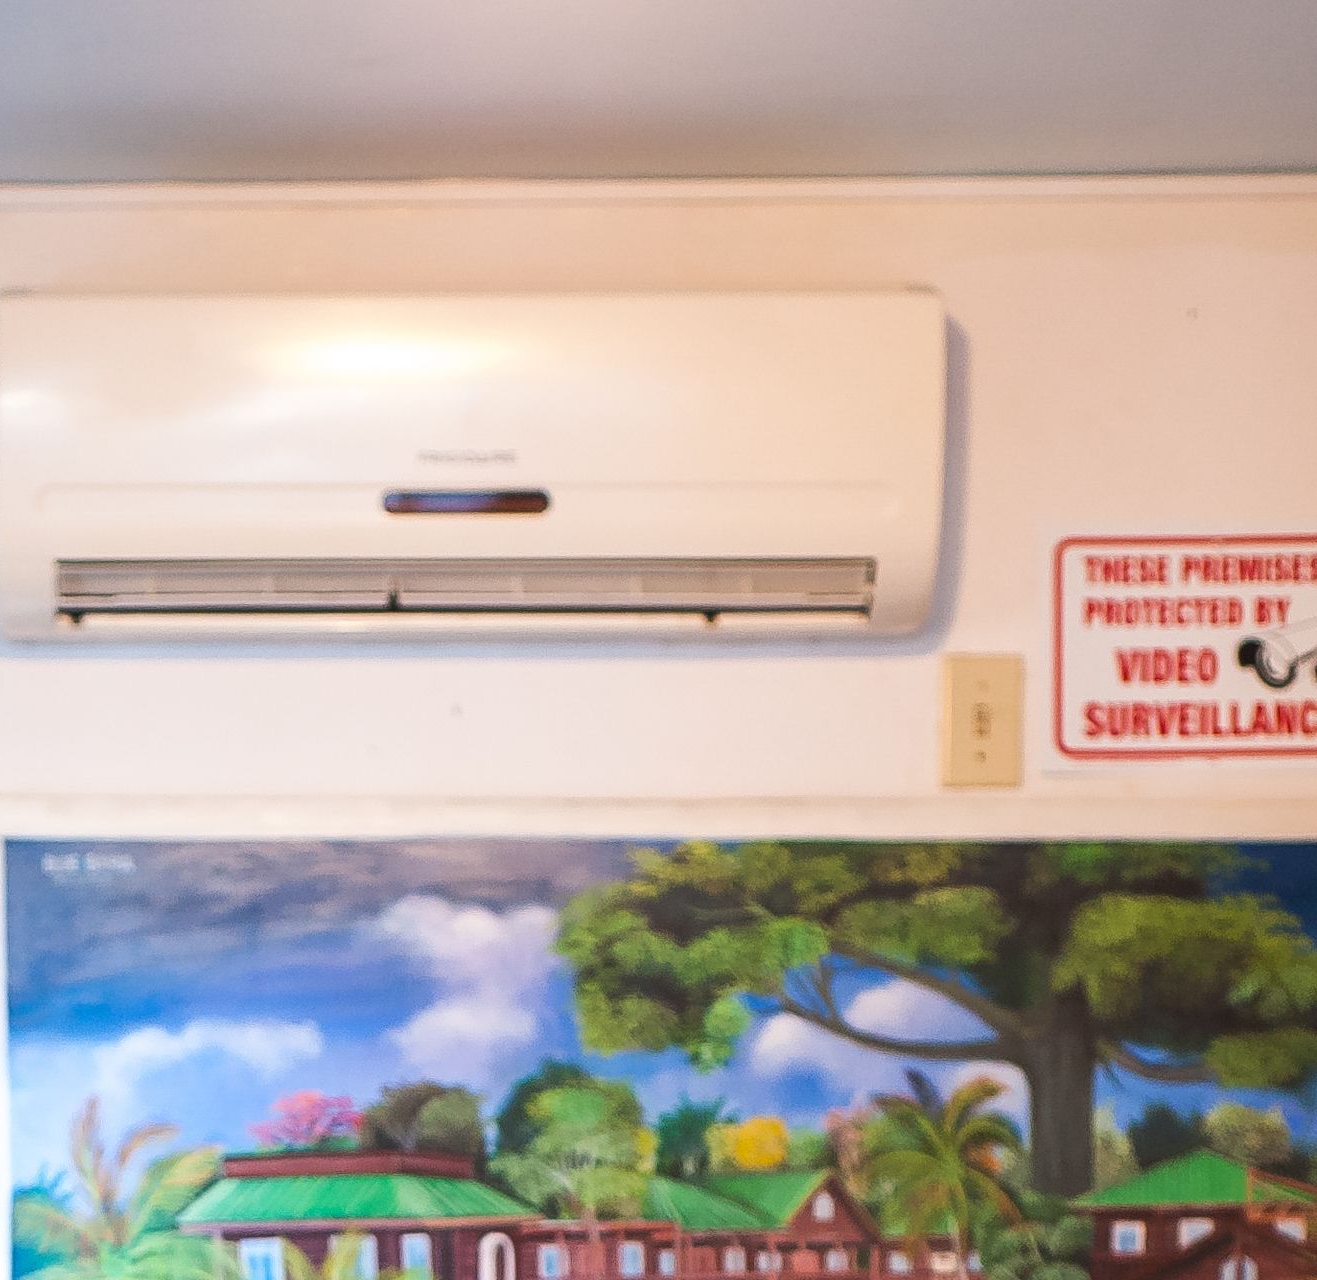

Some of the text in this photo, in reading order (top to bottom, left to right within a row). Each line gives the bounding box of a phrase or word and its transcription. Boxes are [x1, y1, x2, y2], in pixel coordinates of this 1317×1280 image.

[1084, 555, 1168, 583] THESE
[1083, 596, 1290, 626] PROTECTED BY
[1115, 648, 1219, 683] VIDEO
[1083, 700, 1317, 737] SURVEILLANC
